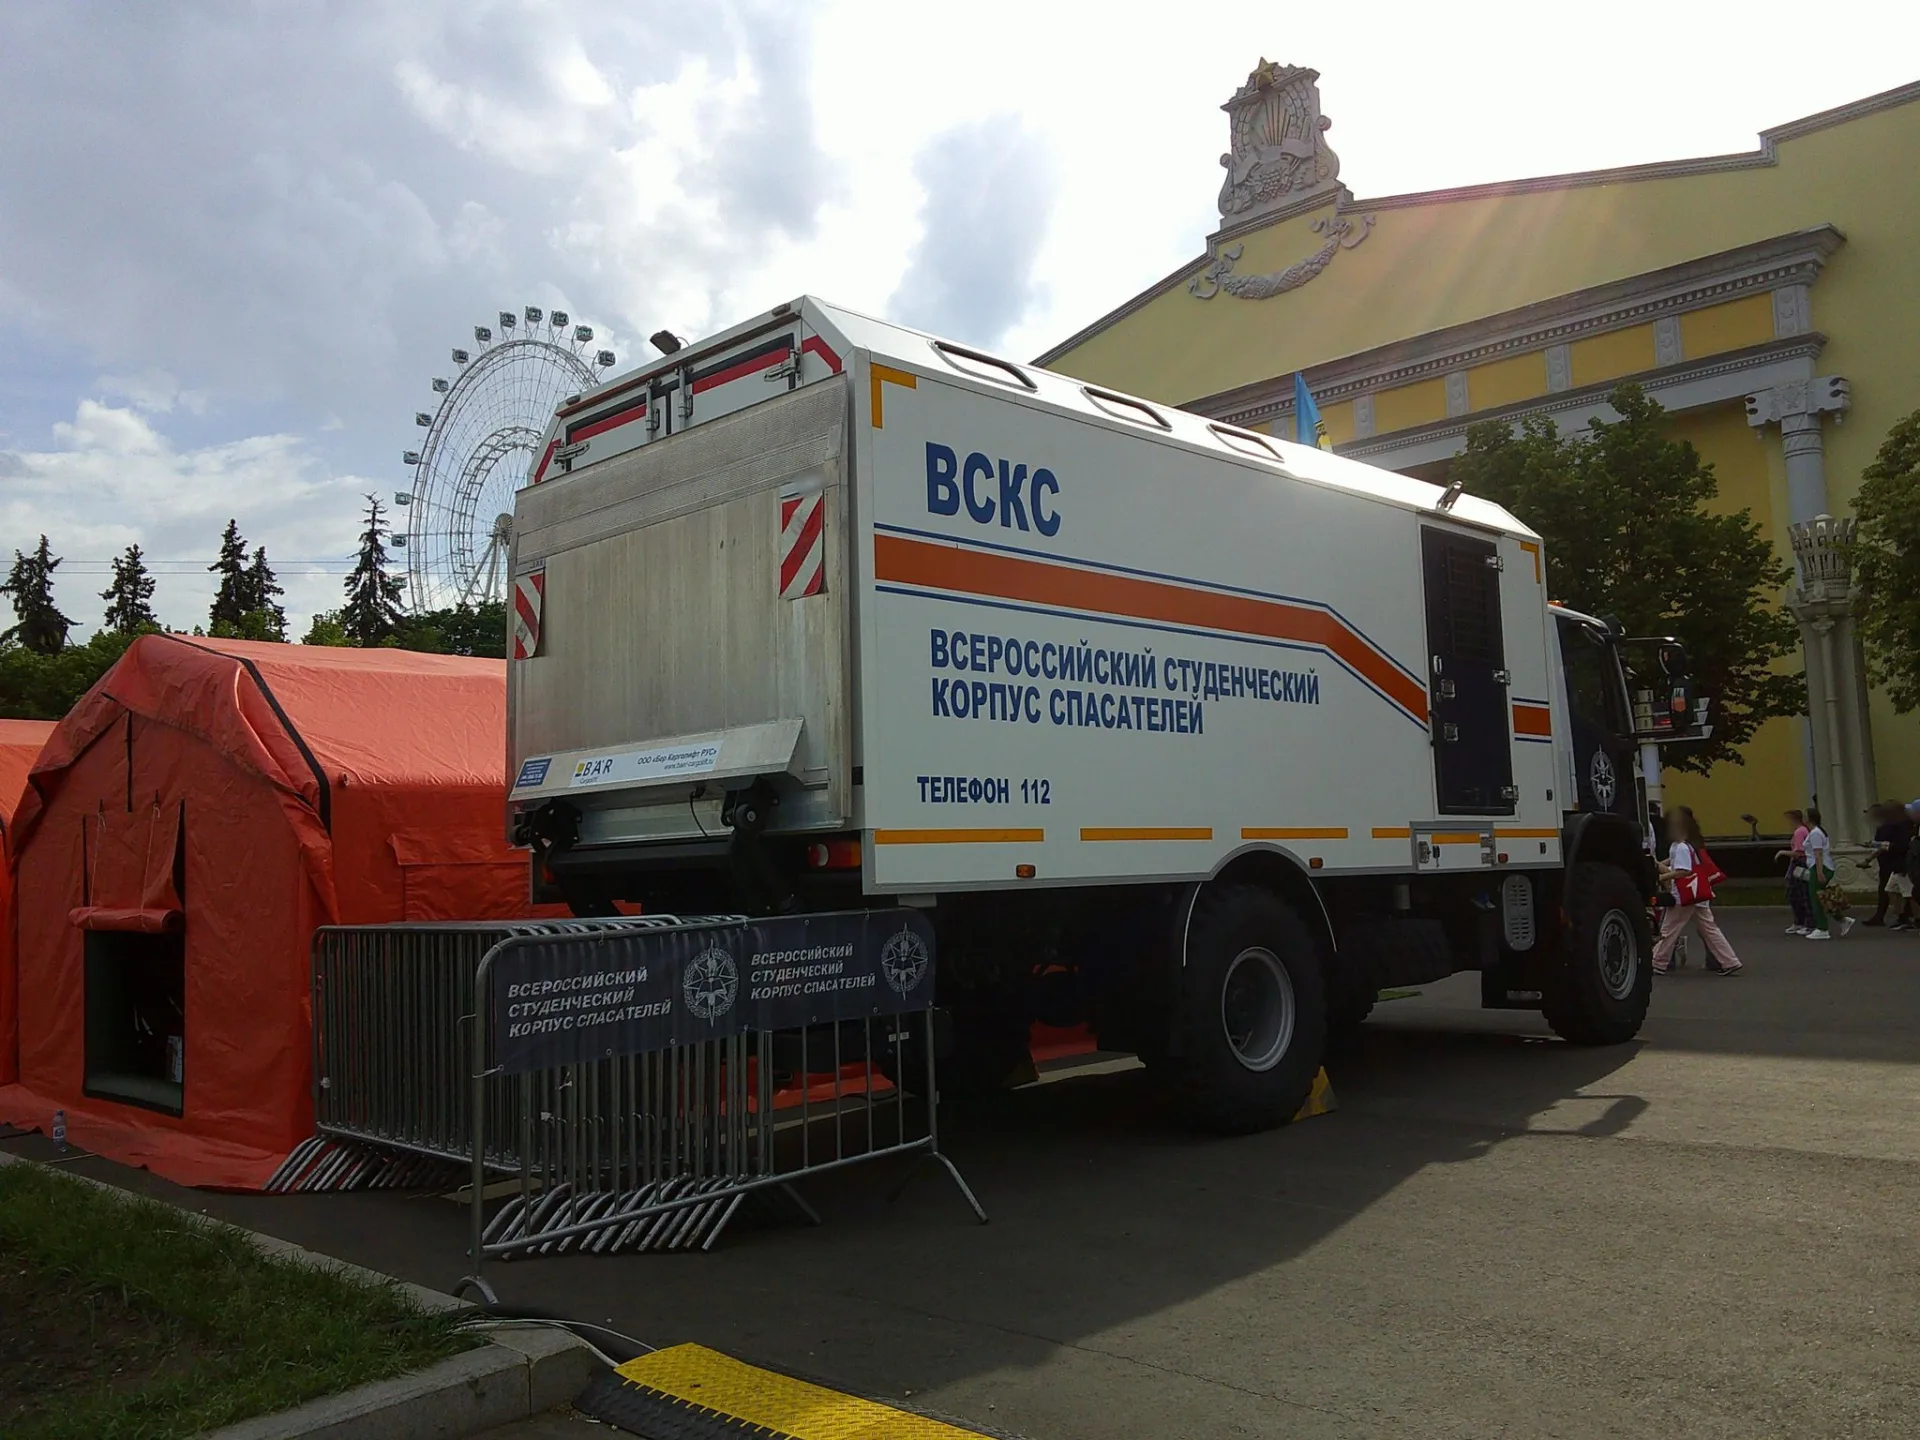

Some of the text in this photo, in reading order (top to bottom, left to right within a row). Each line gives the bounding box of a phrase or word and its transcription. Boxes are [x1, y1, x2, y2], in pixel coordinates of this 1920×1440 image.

[926, 441, 1061, 537] ВСКС
[931, 628, 1320, 704] ВСЕРОССИЙСКИЙ СТУДЕНЧЕСКИЙ
[932, 678, 1204, 734] КОРПУС СПАСАТЕЛЕЙ
[637, 756, 652, 765] ООО
[917, 776, 1051, 804] ТЕЛЕФОН 112
[751, 943, 853, 966] ВСЕРОССИЙСКИЙ
[508, 966, 648, 998] ВСЕРОССИЙСКИЙ
[751, 960, 844, 983] СТУДЕНЧЕСКИЙ
[751, 972, 876, 999] КОРПУС СПАСАТЕЛЕЙ
[508, 987, 635, 1018] СТУДЕНЧЕСКИЙ
[509, 998, 672, 1037] КОРПУС СПАСАТЕЛЕЙ
